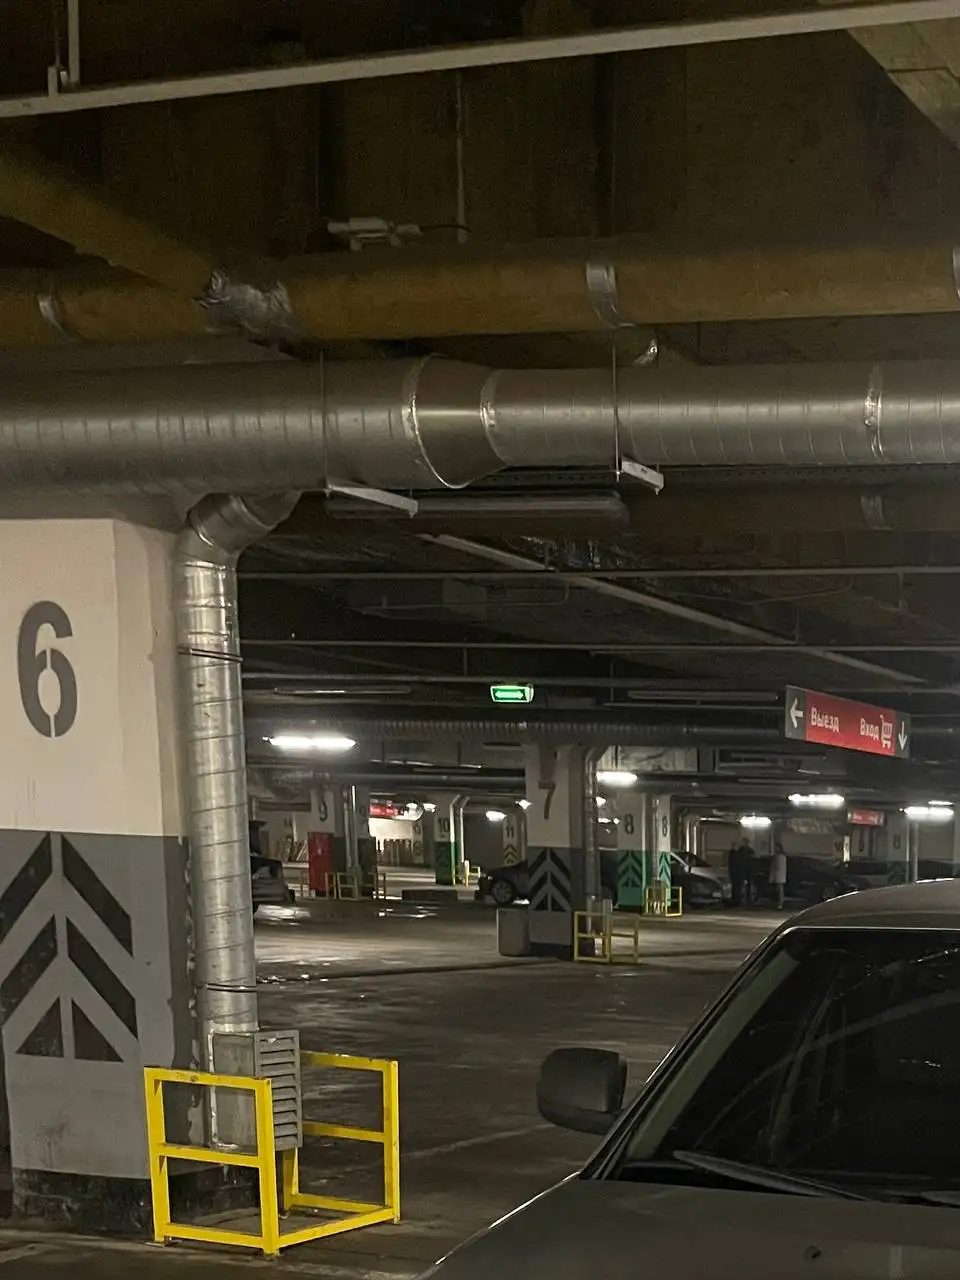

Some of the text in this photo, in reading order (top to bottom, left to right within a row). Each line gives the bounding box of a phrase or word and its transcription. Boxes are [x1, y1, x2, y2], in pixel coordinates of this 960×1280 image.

[16, 600, 78, 738] 6
[810, 707, 840, 733] Выезд
[860, 718, 879, 741] Вход
[538, 780, 556, 819] 7
[624, 813, 634, 835] 8
[662, 816, 668, 837] 8
